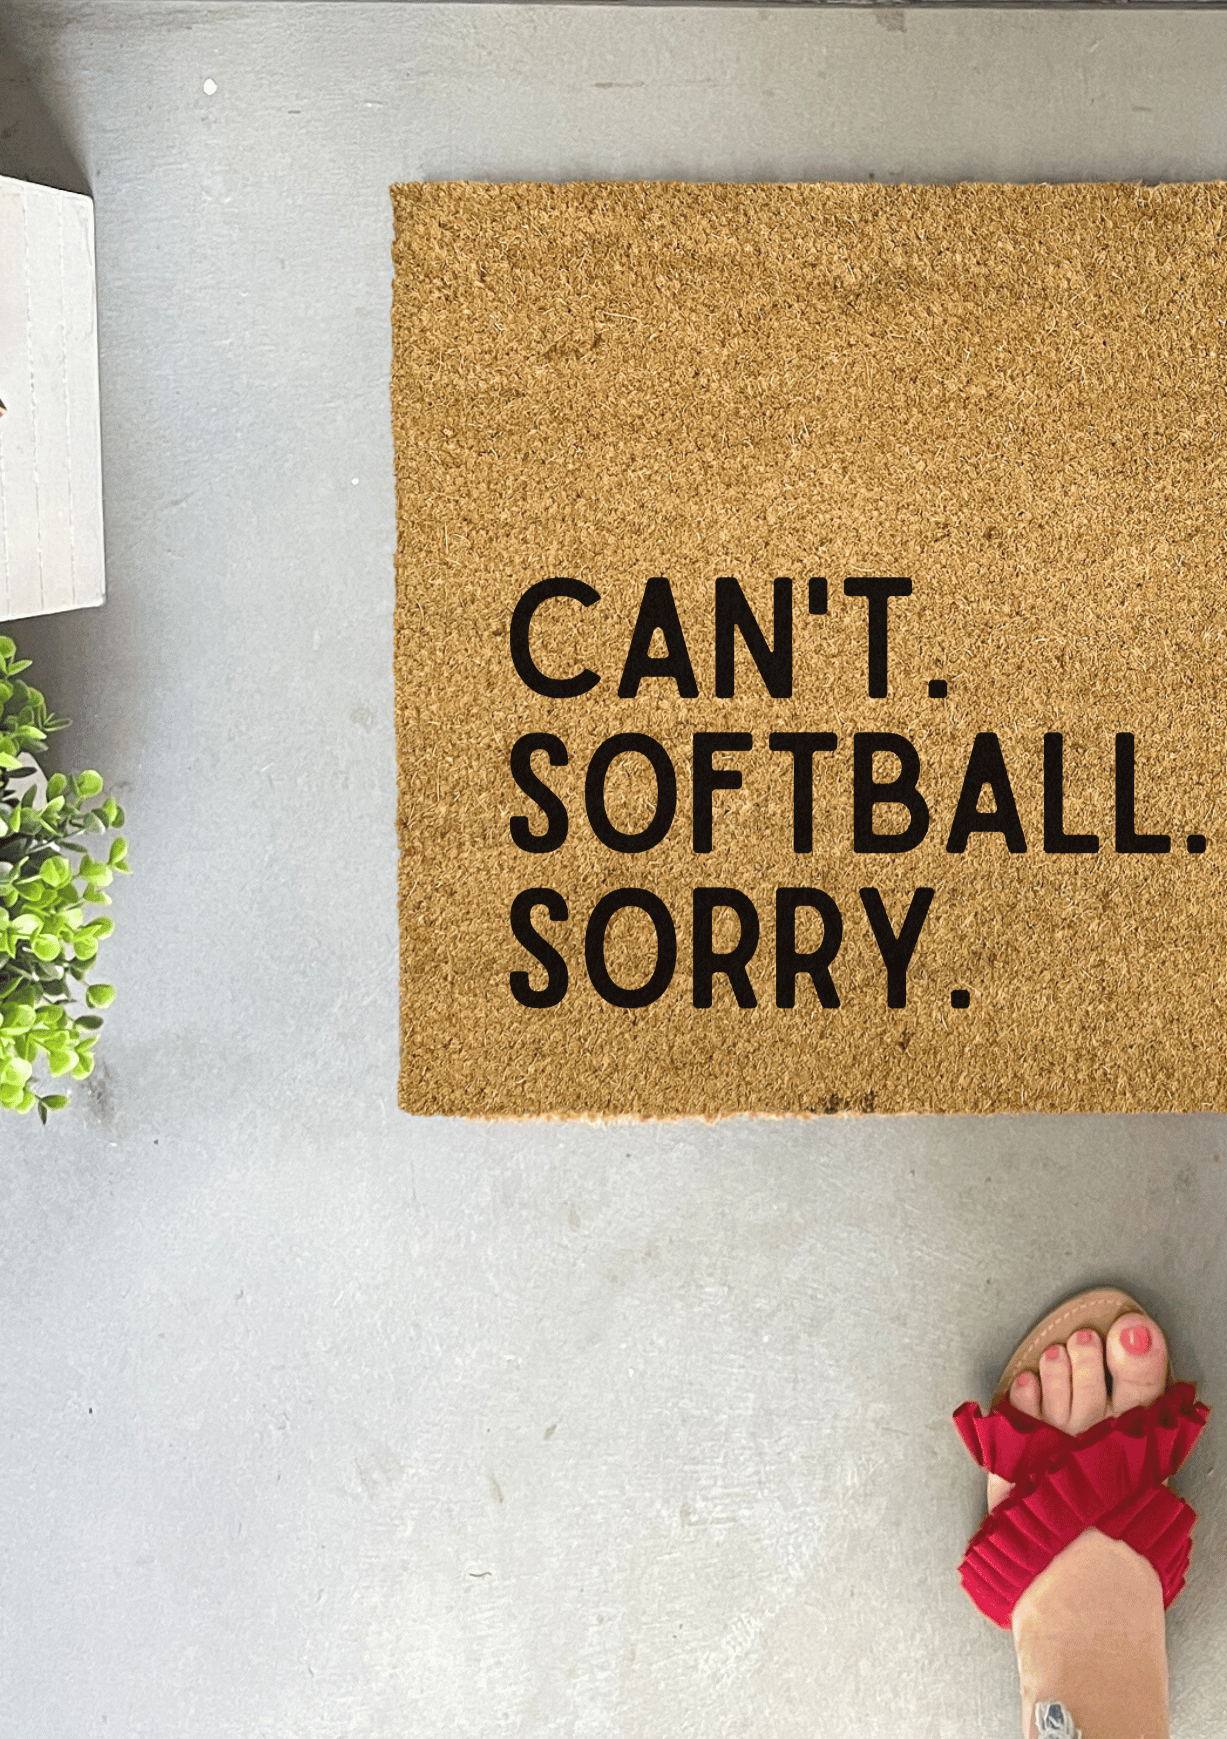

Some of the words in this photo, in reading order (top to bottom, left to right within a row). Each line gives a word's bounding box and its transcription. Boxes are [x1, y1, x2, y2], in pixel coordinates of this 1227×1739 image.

[509, 576, 948, 699] CAN'T.
[509, 731, 1207, 854] SOFTBALL.
[509, 886, 971, 1010] SORRY.
